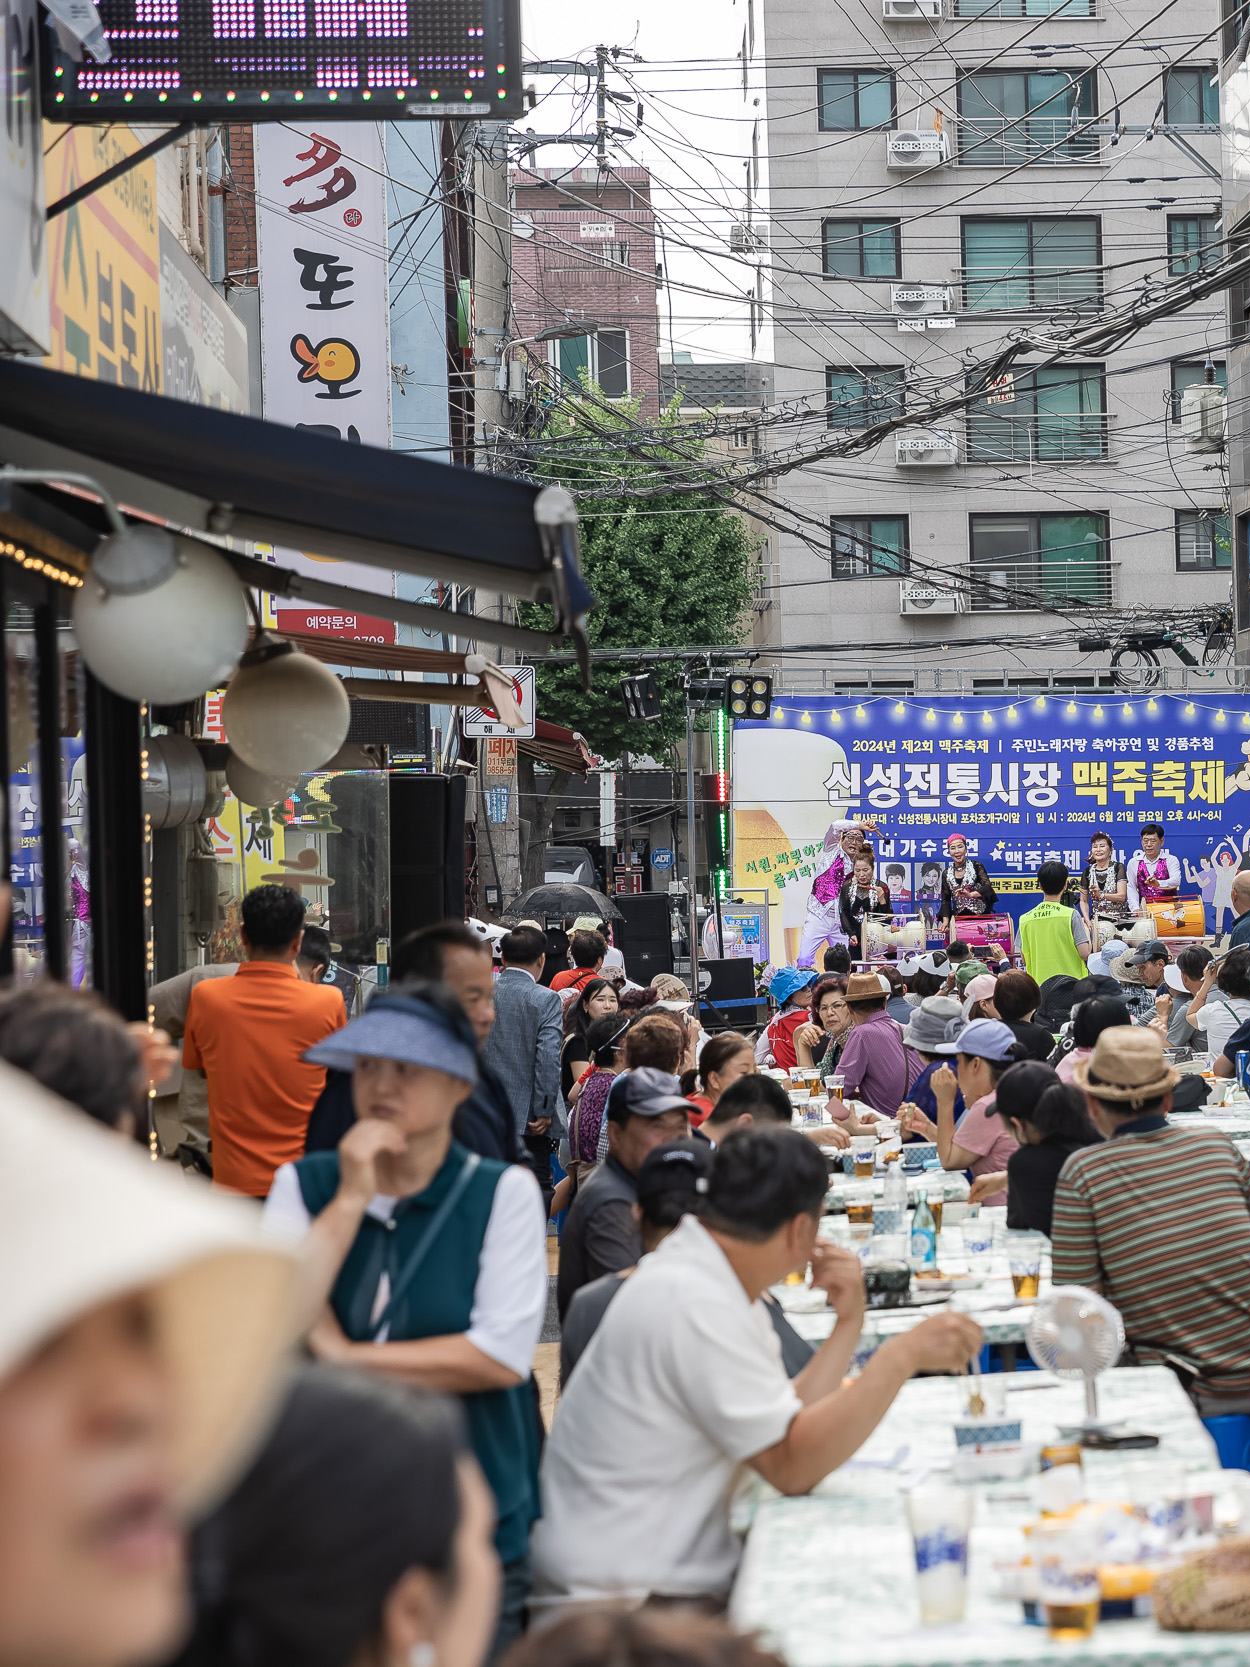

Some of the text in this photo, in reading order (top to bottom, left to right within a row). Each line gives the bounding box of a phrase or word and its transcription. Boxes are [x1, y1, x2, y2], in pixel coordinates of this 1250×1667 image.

[283, 132, 357, 214] 多
[306, 616, 357, 630] 예약문의
[853, 737, 1214, 754] 2024년 제2회 맥주축제 주민노래자랑 축하공연 및 경품추첨
[823, 760, 1225, 808] 신성전통시장 맥주축제
[897, 813, 957, 825] 신성전통시장내
[960, 812, 1020, 825] 포차조개구이앞
[1067, 812, 1096, 823] 2024년
[1099, 811, 1114, 823] 6월
[1116, 811, 1134, 823] 21일
[1137, 811, 1163, 822] 금요일
[1166, 810, 1184, 822] 오후
[1187, 810, 1222, 822] 4시~8시
[655, 854, 671, 863] ADT
